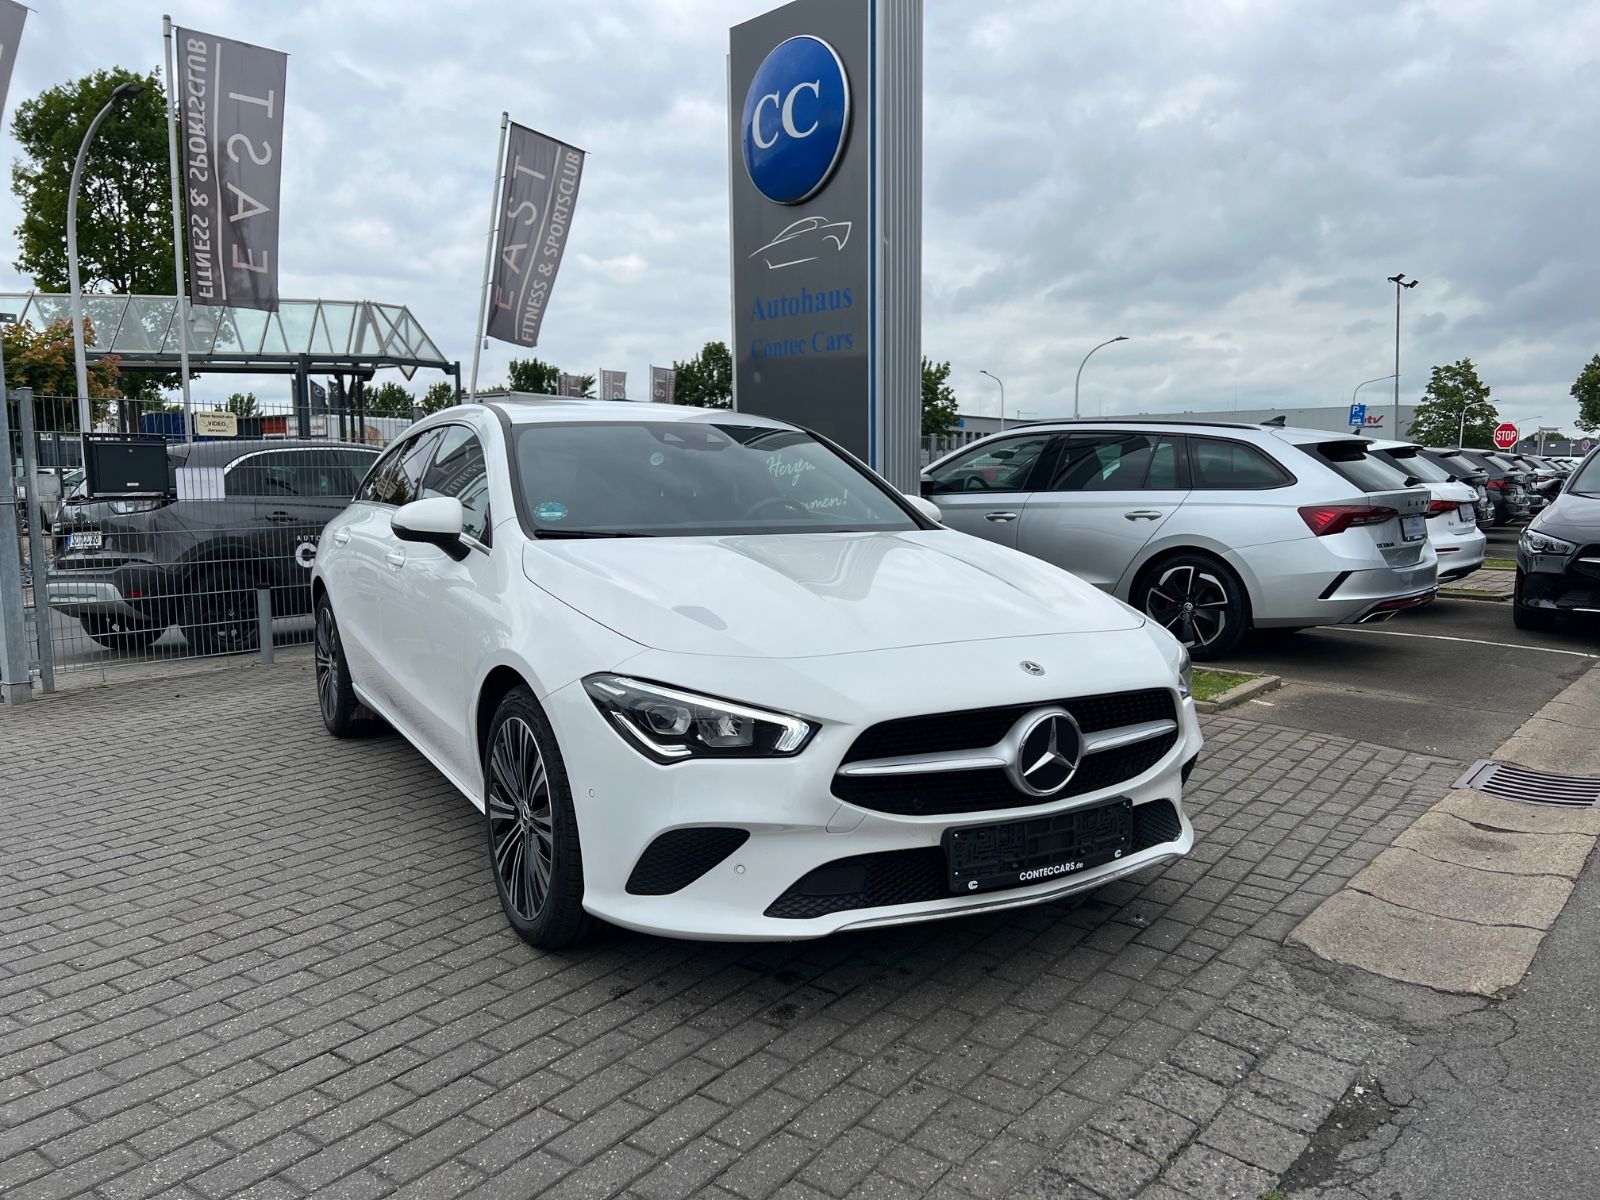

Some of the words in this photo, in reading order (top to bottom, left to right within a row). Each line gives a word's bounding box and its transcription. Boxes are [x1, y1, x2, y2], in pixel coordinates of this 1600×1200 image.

[752, 79, 820, 149] CC
[544, 151, 580, 258] SPORTSCLUB
[495, 155, 546, 310] EAST
[538, 262, 554, 276] &
[522, 280, 548, 342] FITNESS
[751, 287, 853, 321] Autohaus
[751, 337, 806, 358] Contec
[812, 330, 853, 353] Cars
[1352, 406, 1360, 415] P
[1496, 430, 1516, 441] STOP
[1019, 861, 1084, 881] CONTECCARS.de
